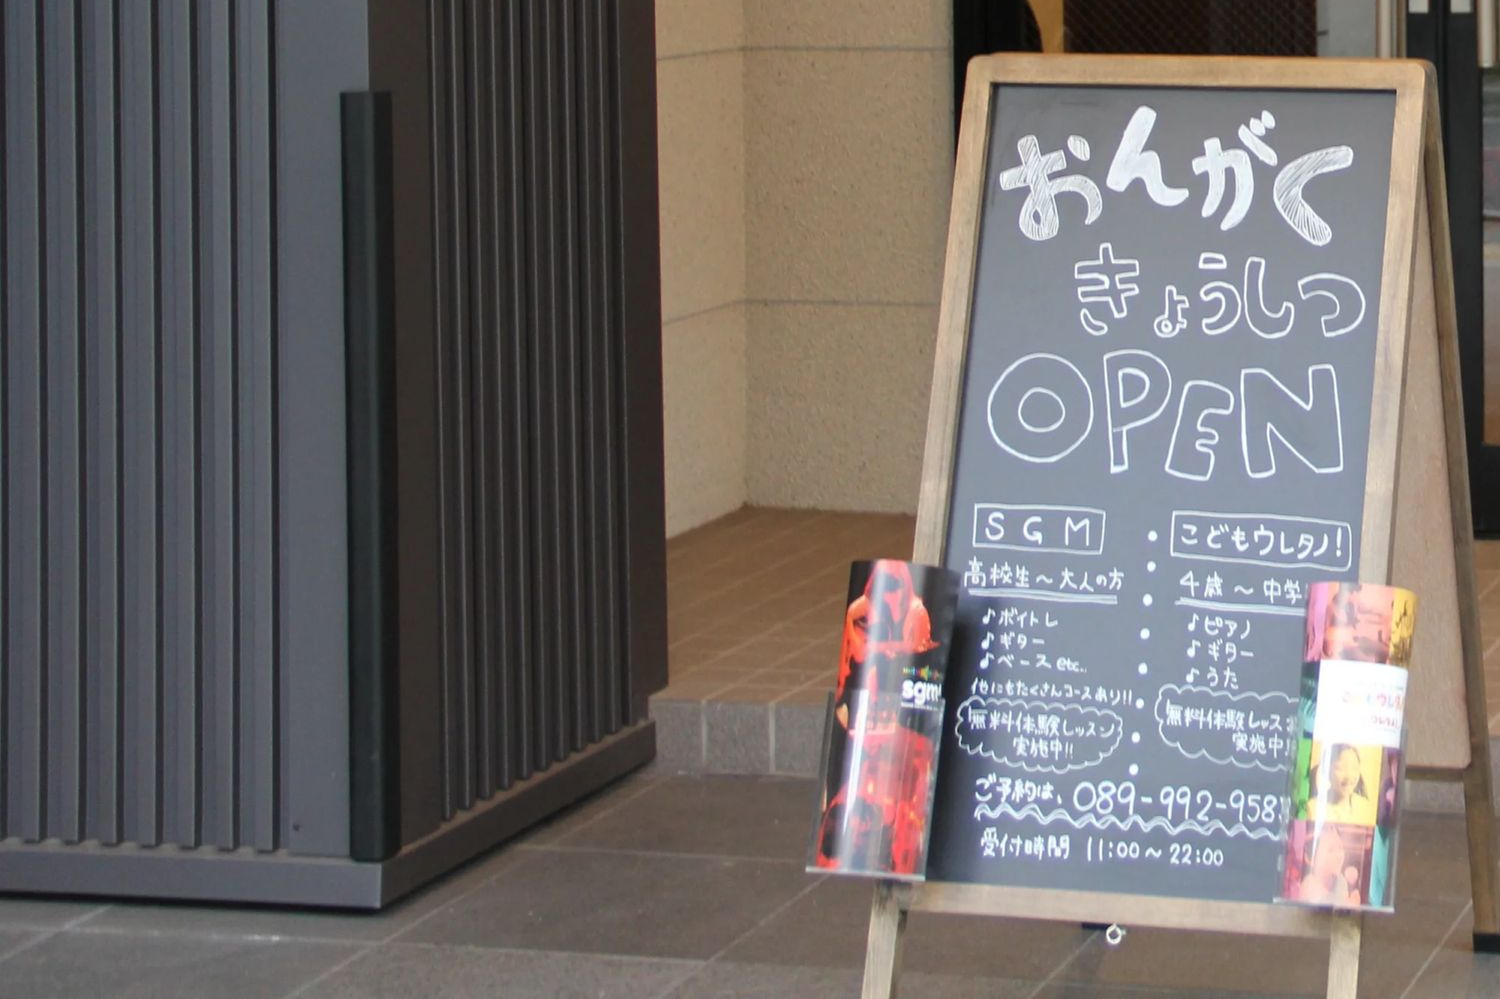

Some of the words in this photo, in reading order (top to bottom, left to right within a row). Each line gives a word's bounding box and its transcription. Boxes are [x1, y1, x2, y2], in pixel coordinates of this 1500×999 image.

[1000, 105, 1354, 246] おんがく
[1074, 242, 1366, 339] きょうしつ
[987, 349, 1343, 481] OPEN
[1181, 522, 1343, 560] こどもウレタノ!
[1179, 570, 1309, 605] 4歳～中学
[999, 607, 1058, 629] ボイトレ
[1204, 615, 1250, 640] ピアノ
[999, 632, 1045, 650] ギター
[1208, 638, 1254, 664] ギター
[997, 653, 1051, 669] ベース
[1206, 666, 1239, 690] うた
[968, 706, 1115, 737] 無料体験レッスン
[980, 826, 1070, 861] 受付時間
